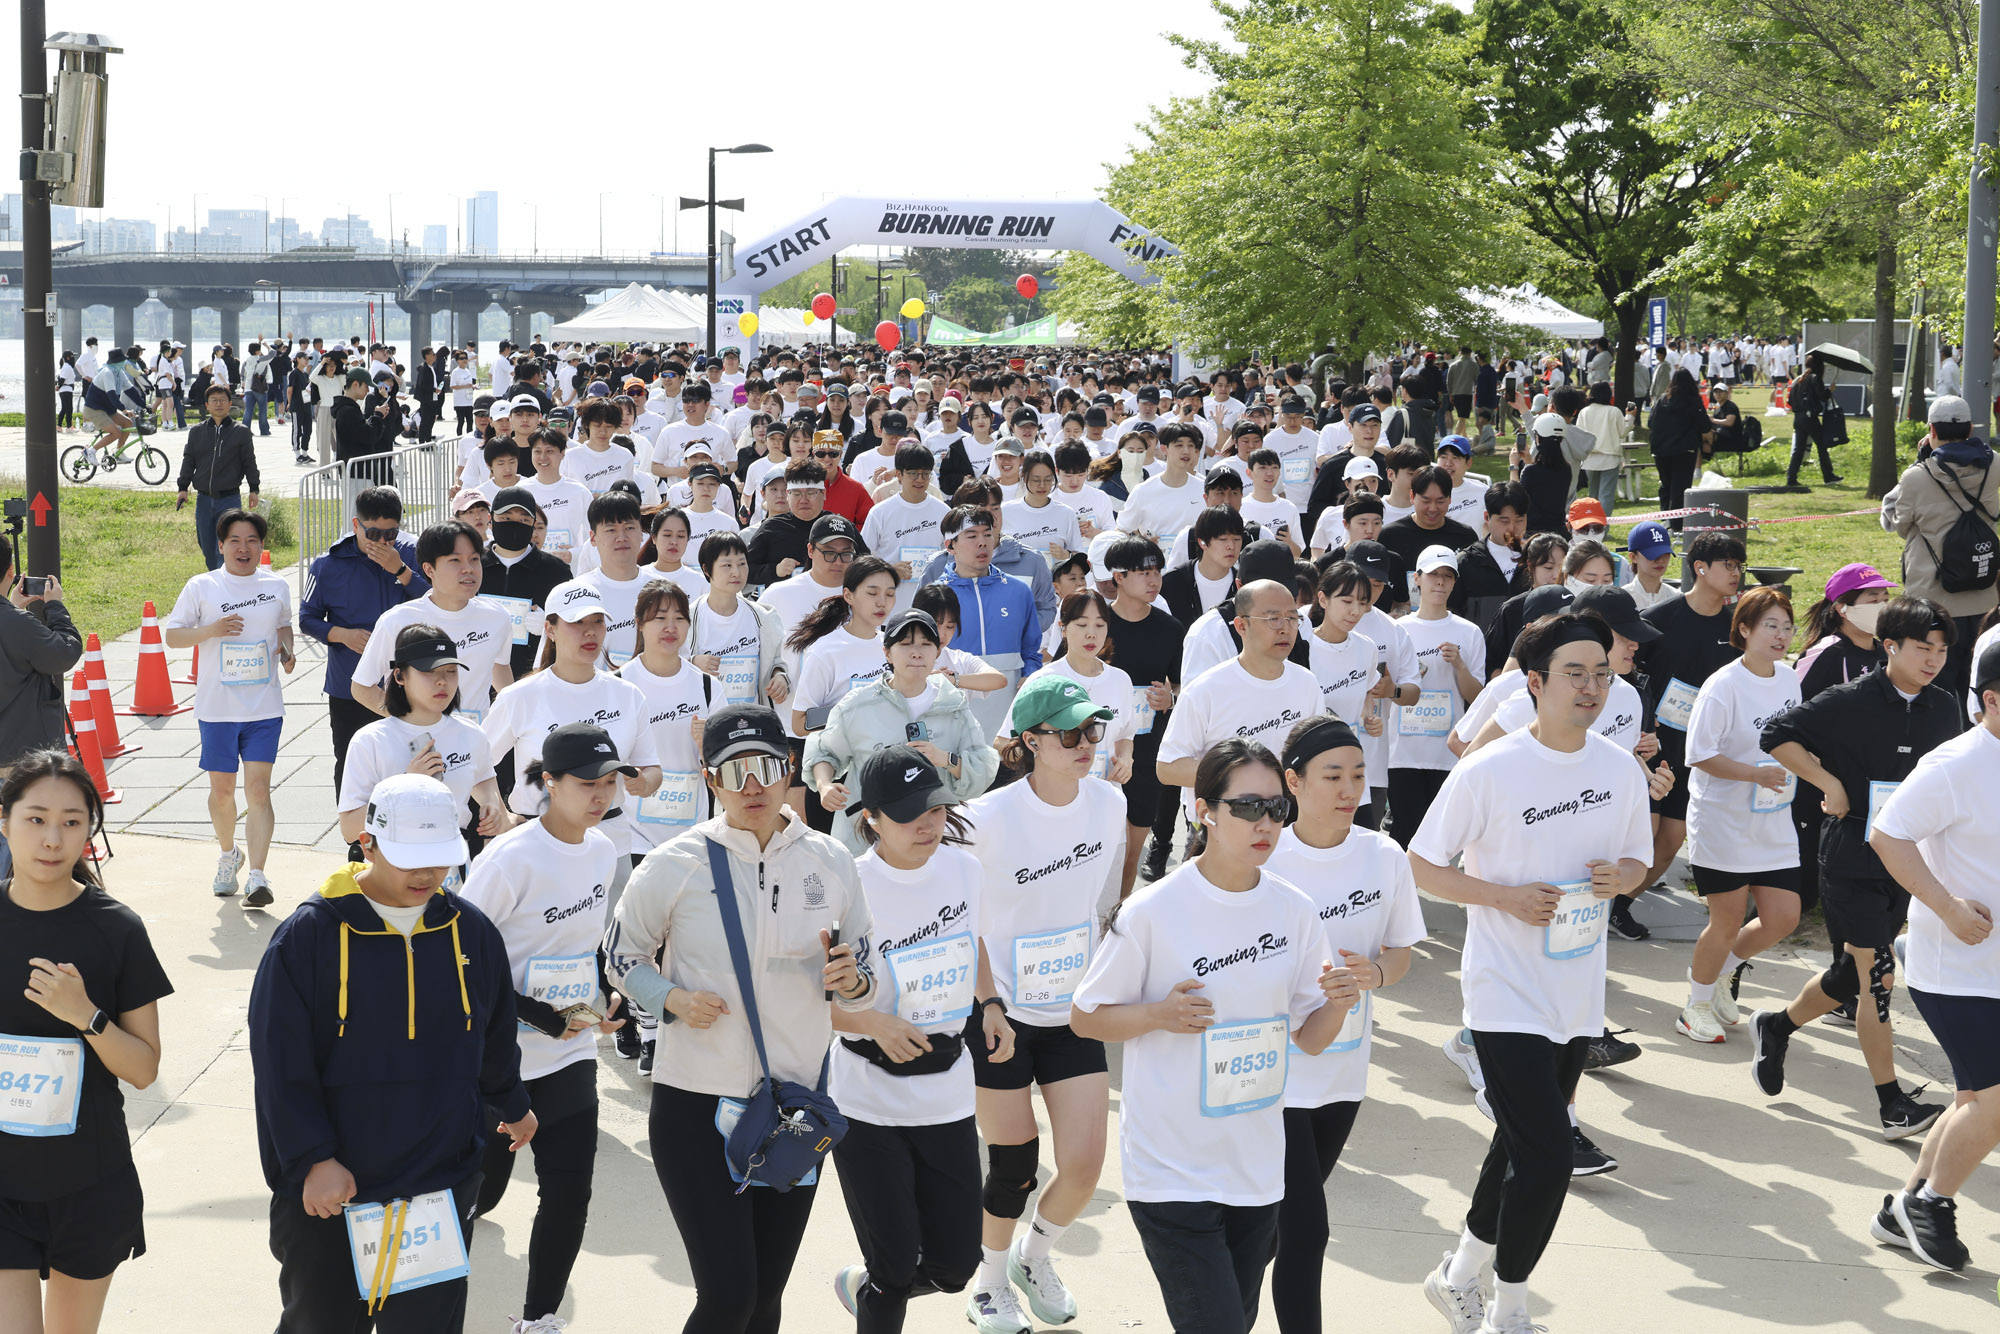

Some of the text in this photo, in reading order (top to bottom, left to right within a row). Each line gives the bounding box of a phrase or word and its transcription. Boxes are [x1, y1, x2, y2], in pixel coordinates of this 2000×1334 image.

[878, 213, 1055, 237] BURNING RUN
[746, 217, 832, 278] START
[584, 464, 622, 482] Burning Run
[895, 520, 937, 538] Burning Run
[1041, 526, 1058, 534] Run
[1650, 528, 1664, 542] LA
[220, 594, 276, 612] Burning Run
[1000, 608, 1008, 617] S
[466, 631, 490, 644] Run
[738, 636, 757, 648] Run
[236, 656, 264, 668] 7336
[726, 672, 754, 684] 8205
[1350, 670, 1367, 682] Run
[676, 702, 700, 716] Run
[1668, 698, 1676, 706] M
[594, 709, 622, 723] Run
[1415, 706, 1446, 717] 8030
[1236, 709, 1302, 737] Burning Run
[1616, 714, 1633, 730] Run
[446, 752, 471, 768] Run
[906, 766, 919, 776] NIKE
[658, 790, 693, 802] 8561
[1522, 789, 1612, 825] Burning Run
[1014, 856, 1073, 884] Burning
[1072, 842, 1102, 862] Run
[804, 872, 824, 888] SEOUL
[1348, 889, 1382, 910] Run
[544, 896, 593, 924] Burning
[1556, 902, 1605, 926] M 7057
[878, 900, 968, 958] Burning Run
[1020, 936, 1066, 949] BURNING RUN
[896, 946, 947, 964] BURNING RUN
[1192, 946, 1259, 977] Burning
[1258, 932, 1288, 955] Run
[534, 962, 578, 971] BURNING RUN
[1024, 952, 1084, 976] W 8398
[906, 964, 968, 992] W 8437
[532, 982, 591, 1000] W 8438
[1026, 992, 1049, 1001] D-26
[912, 1010, 936, 1020] B-98
[1211, 1028, 1262, 1042] BURNING RUN
[20, 1045, 40, 1054] RUN
[1214, 1050, 1278, 1076] W 8539
[0, 1070, 64, 1096] 8471
[426, 1196, 443, 1206] 7km
[356, 1209, 386, 1223] BURNIN
[364, 1242, 376, 1256] M
